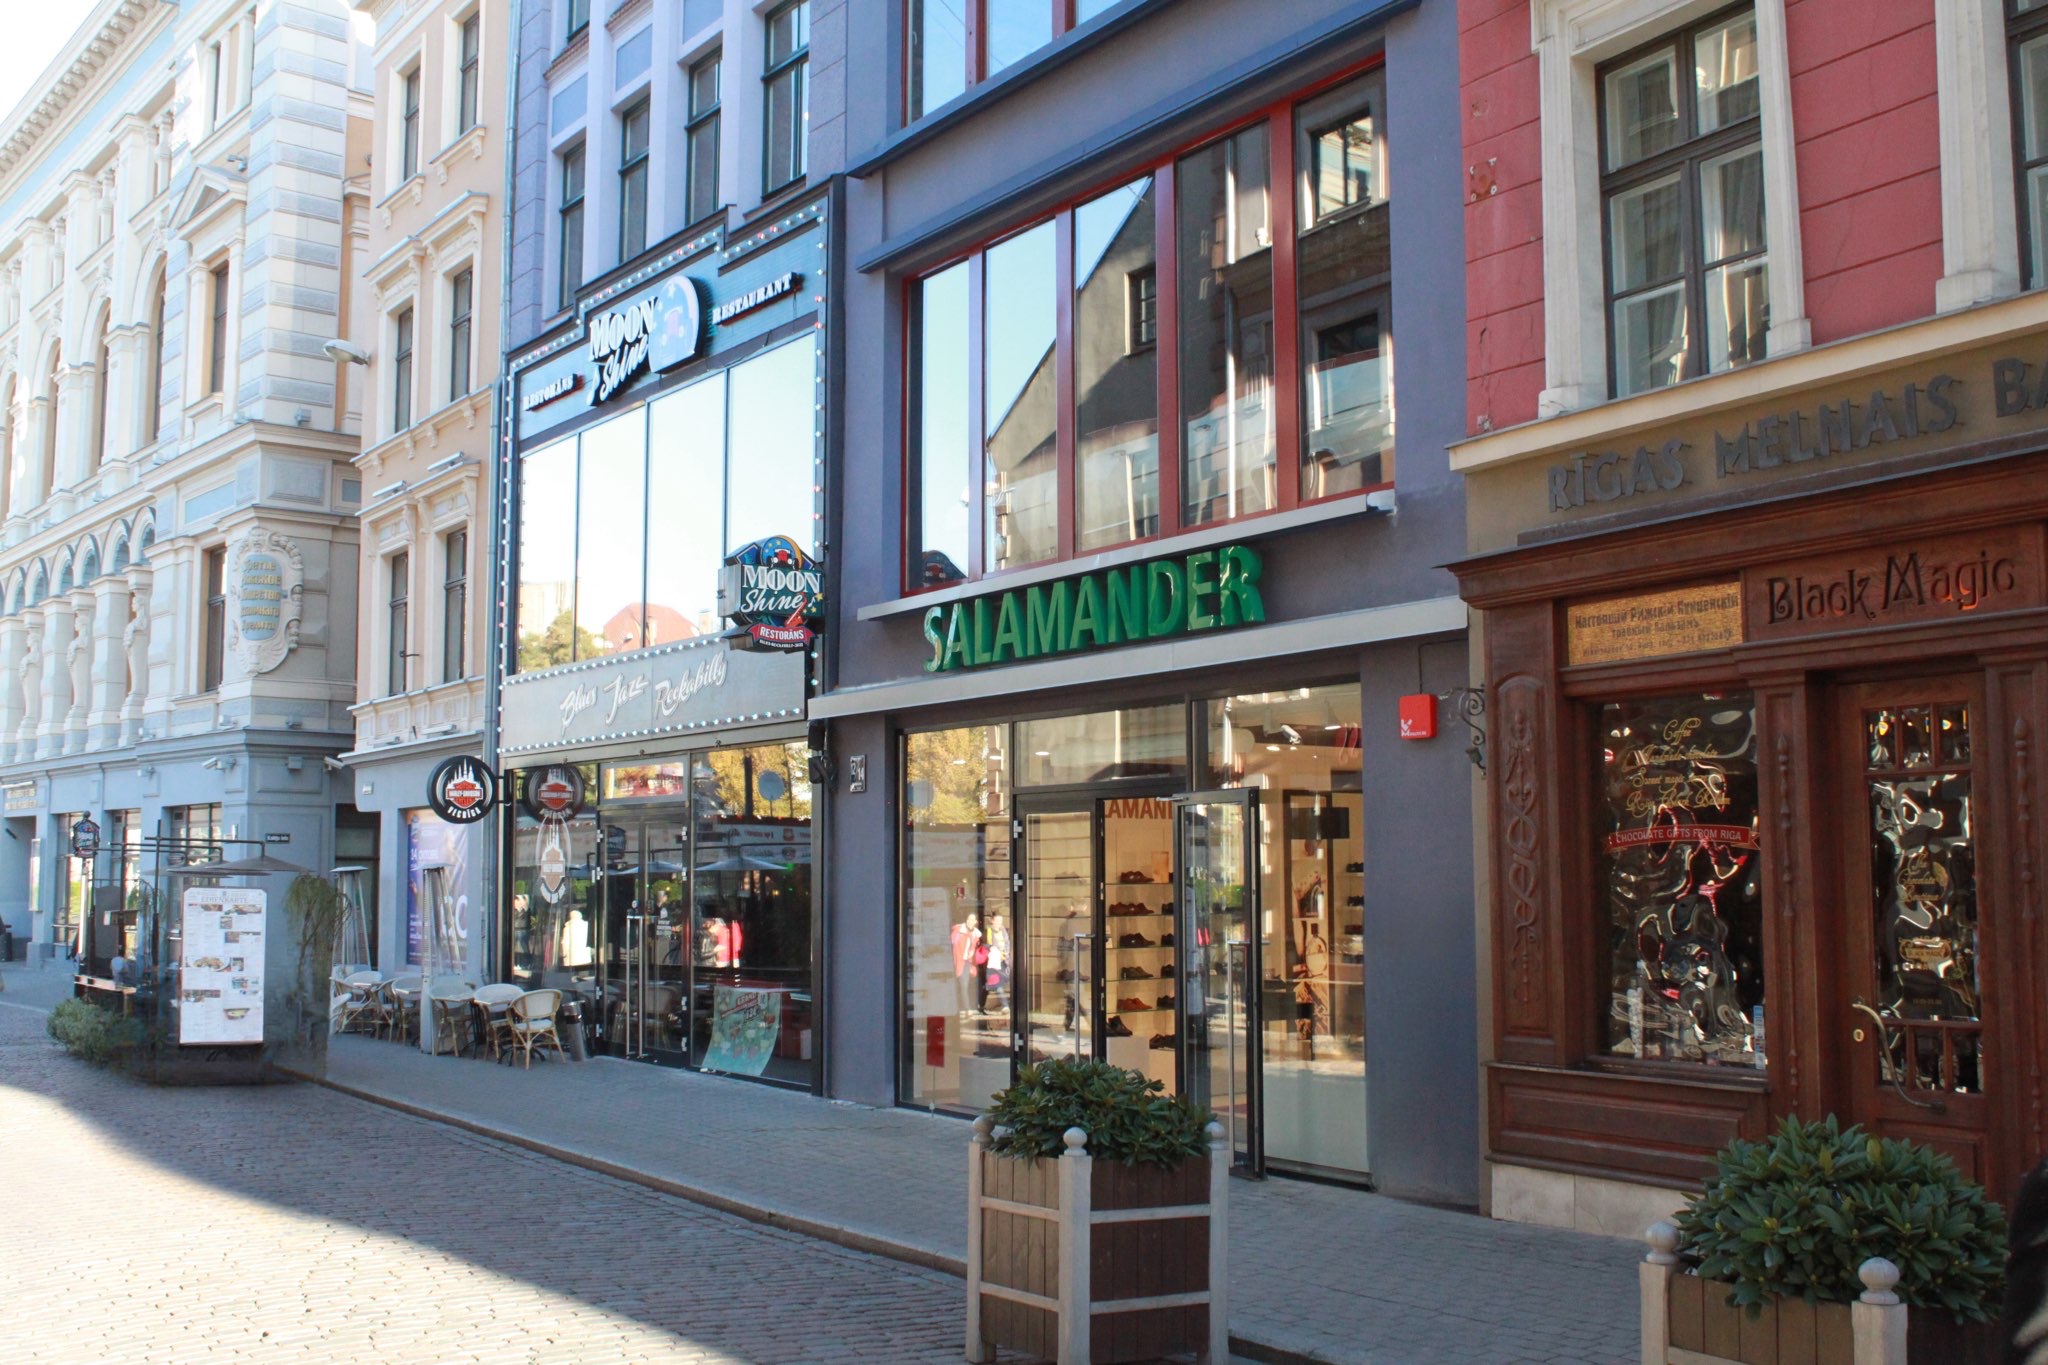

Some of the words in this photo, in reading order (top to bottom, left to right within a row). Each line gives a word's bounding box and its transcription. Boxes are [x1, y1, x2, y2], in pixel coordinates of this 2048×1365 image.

[712, 272, 792, 325] RESTAURANT
[589, 296, 657, 362] MOON
[600, 334, 648, 401] Shine
[1546, 440, 1685, 514] RĪGAS
[1714, 374, 1958, 479] MELNAIS
[741, 588, 804, 613] Shine
[742, 564, 822, 594] MOON
[1768, 568, 1877, 625] Black
[1882, 551, 2017, 611] Magic
[760, 625, 805, 640] RESTORĀNS
[923, 545, 1266, 673] SALAMANDER
[560, 683, 598, 738] Blues
[603, 672, 649, 726] Jazz
[654, 650, 728, 721] Rockabilly
[1663, 717, 1701, 746] Coffee
[1105, 798, 1173, 820] AMAN
[1616, 829, 1665, 843] CHOCOLATE
[1667, 828, 1691, 839] GIFTS
[1693, 828, 1718, 840] FROM
[1720, 830, 1742, 841] RIGA
